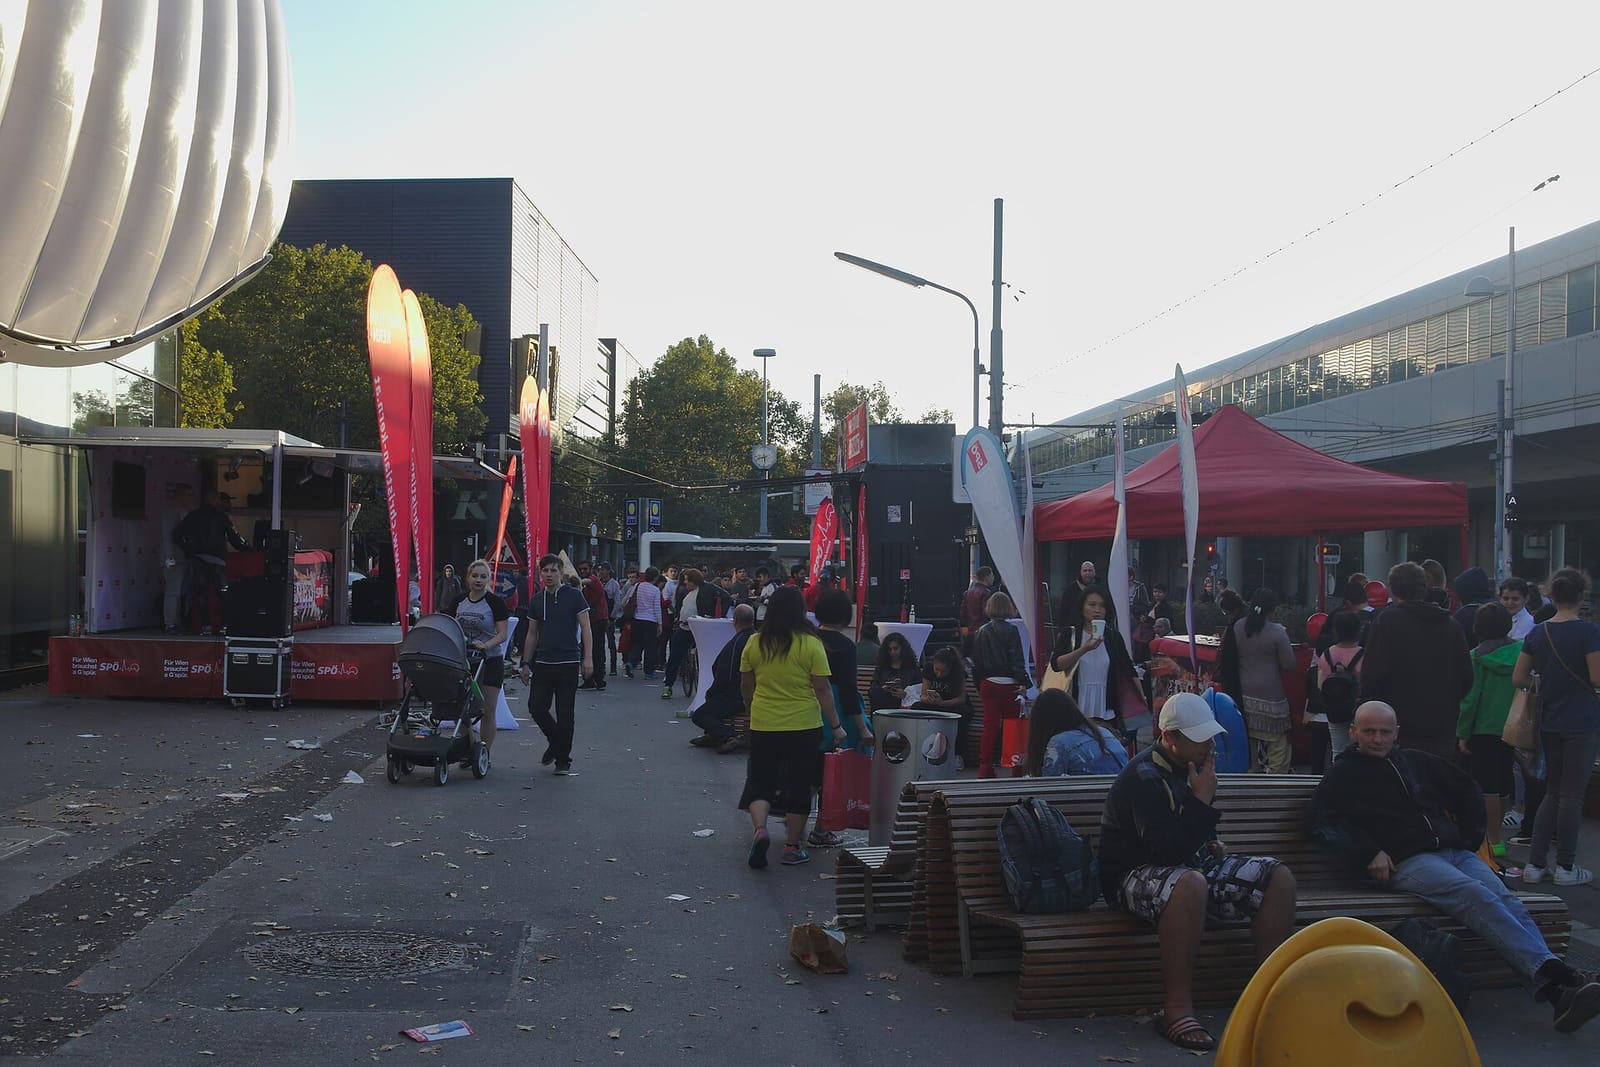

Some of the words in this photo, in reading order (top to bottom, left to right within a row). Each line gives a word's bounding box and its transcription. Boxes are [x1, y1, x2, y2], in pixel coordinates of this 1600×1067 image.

[1509, 496, 1516, 505] A
[72, 655, 82, 663] Für
[99, 661, 119, 671] SPÖ
[164, 665, 189, 673] brauchst
[191, 663, 212, 674] SPÖ
[317, 664, 337, 675] SPÖ
